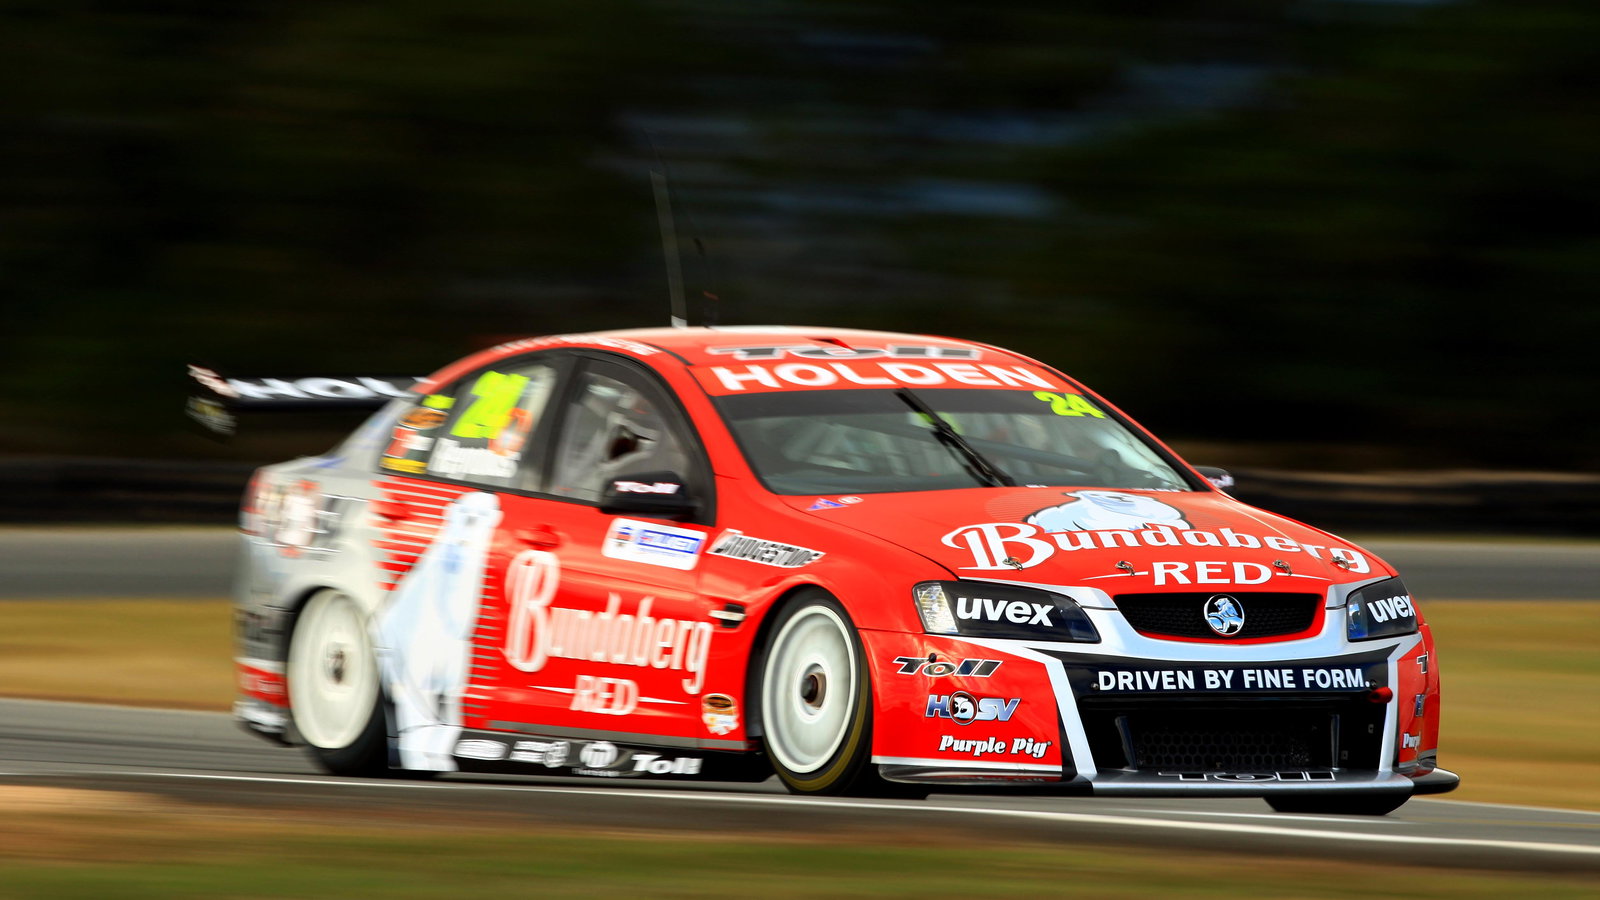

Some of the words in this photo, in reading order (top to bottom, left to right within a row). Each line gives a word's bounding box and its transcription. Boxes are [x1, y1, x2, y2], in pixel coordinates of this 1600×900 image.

[228, 376, 437, 399] HOL
[711, 363, 1057, 390] HOLDEN
[1034, 390, 1106, 419] 24
[941, 522, 1371, 574] Bundaberg
[1153, 561, 1273, 586] RED
[505, 549, 713, 695] Bundaberg
[956, 597, 1054, 627] uvex
[1367, 595, 1416, 623] uvex
[893, 656, 1003, 678] Toll
[1098, 671, 1194, 690] DRIVEN
[1204, 670, 1234, 689] BY
[1243, 669, 1296, 688] FINE
[1302, 668, 1370, 689] FORM.
[569, 674, 640, 716] RED
[938, 735, 1006, 757] Purple
[1010, 737, 1050, 759] Pig
[631, 754, 703, 774] Toll
[1158, 771, 1336, 782] Toll
